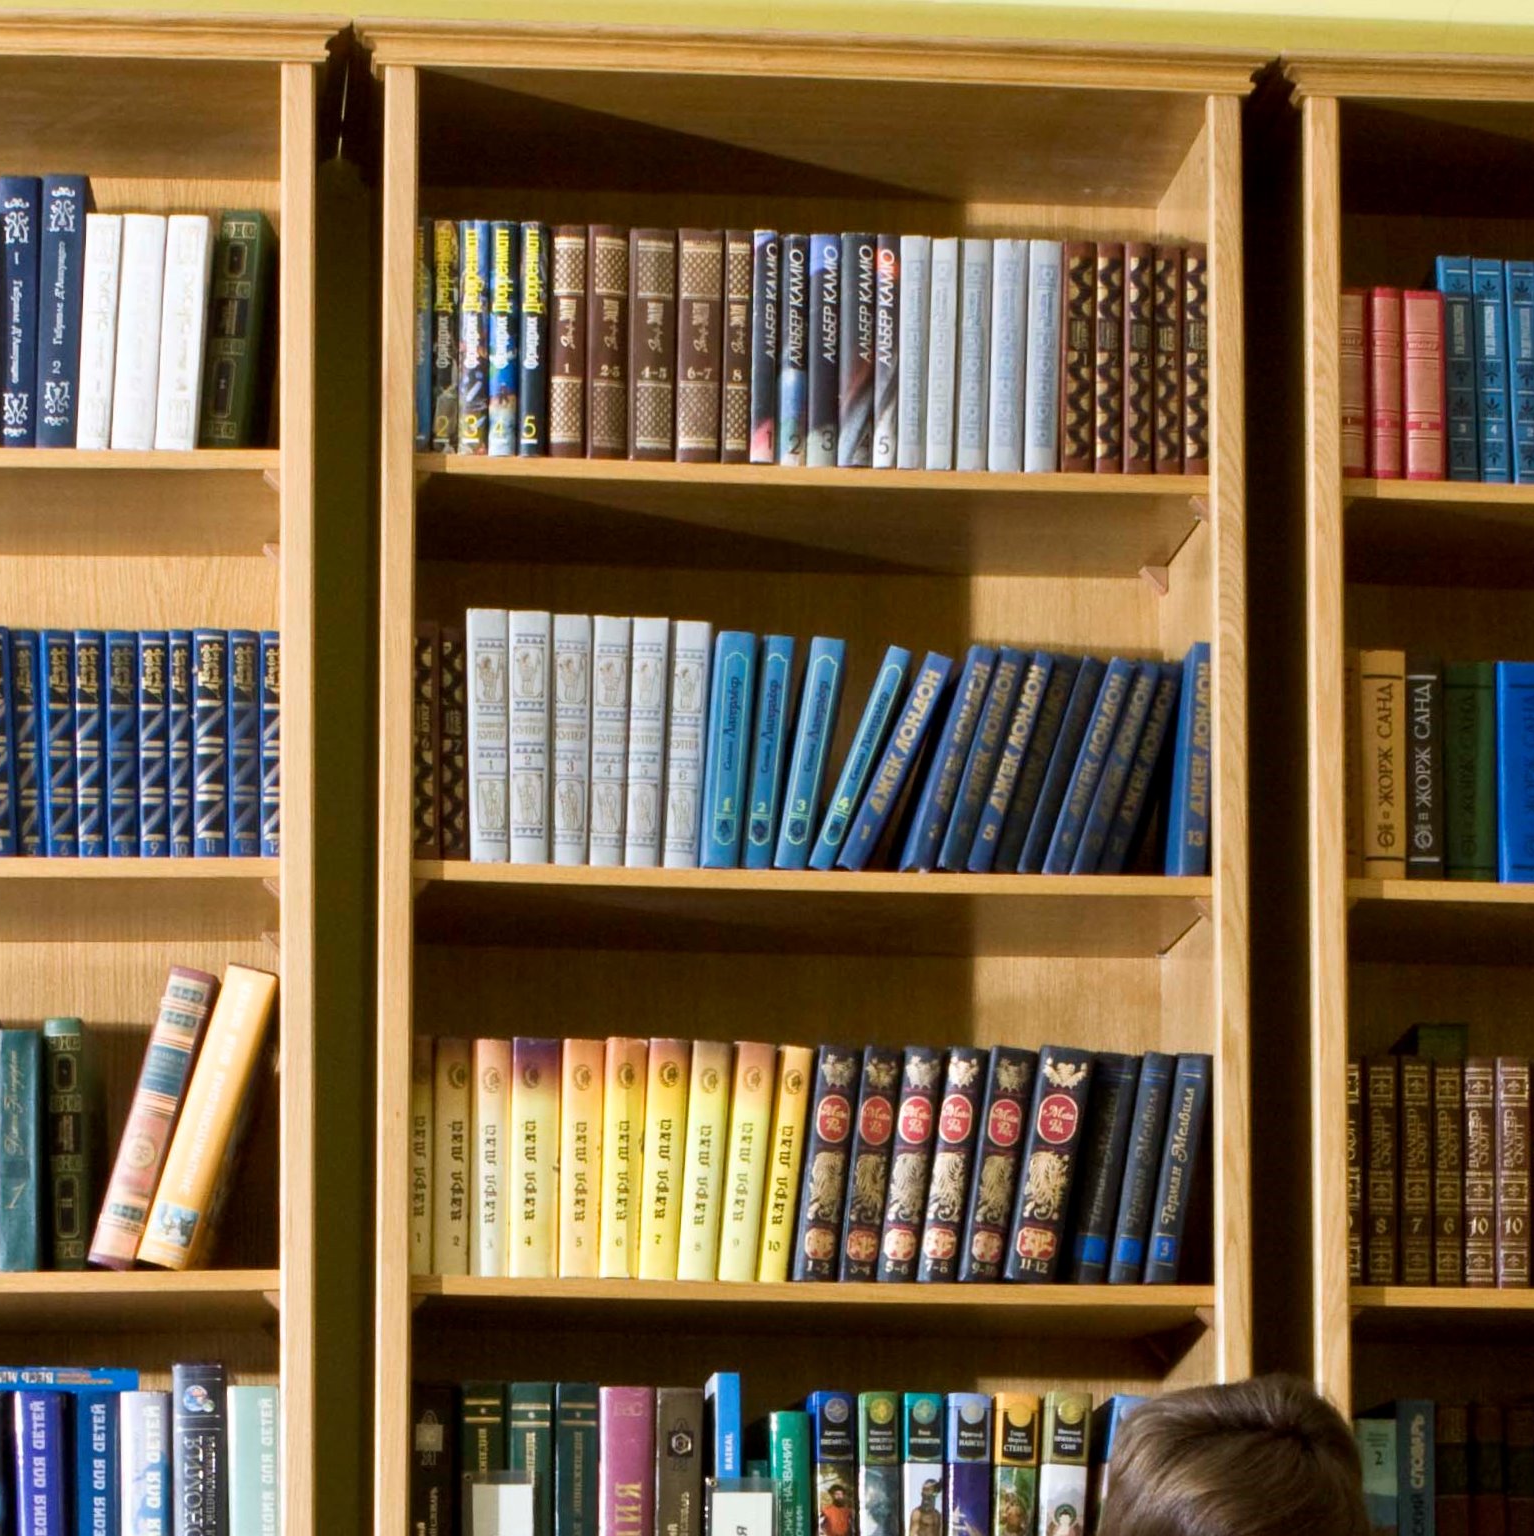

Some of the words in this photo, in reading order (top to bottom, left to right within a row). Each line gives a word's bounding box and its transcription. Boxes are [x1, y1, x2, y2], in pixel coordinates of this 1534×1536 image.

[879, 249, 895, 308] КАМЮ
[878, 309, 893, 367] АЛЬБЕР
[879, 436, 889, 454] 5
[870, 753, 905, 815] ДЖЕК
[895, 669, 941, 755] ЛОНДОН
[778, 1125, 794, 1168] МАЙ
[772, 1176, 789, 1225] КАРЛ
[768, 1241, 781, 1251] 10
[783, 1438, 793, 1502] НАЗВАНИЯ
